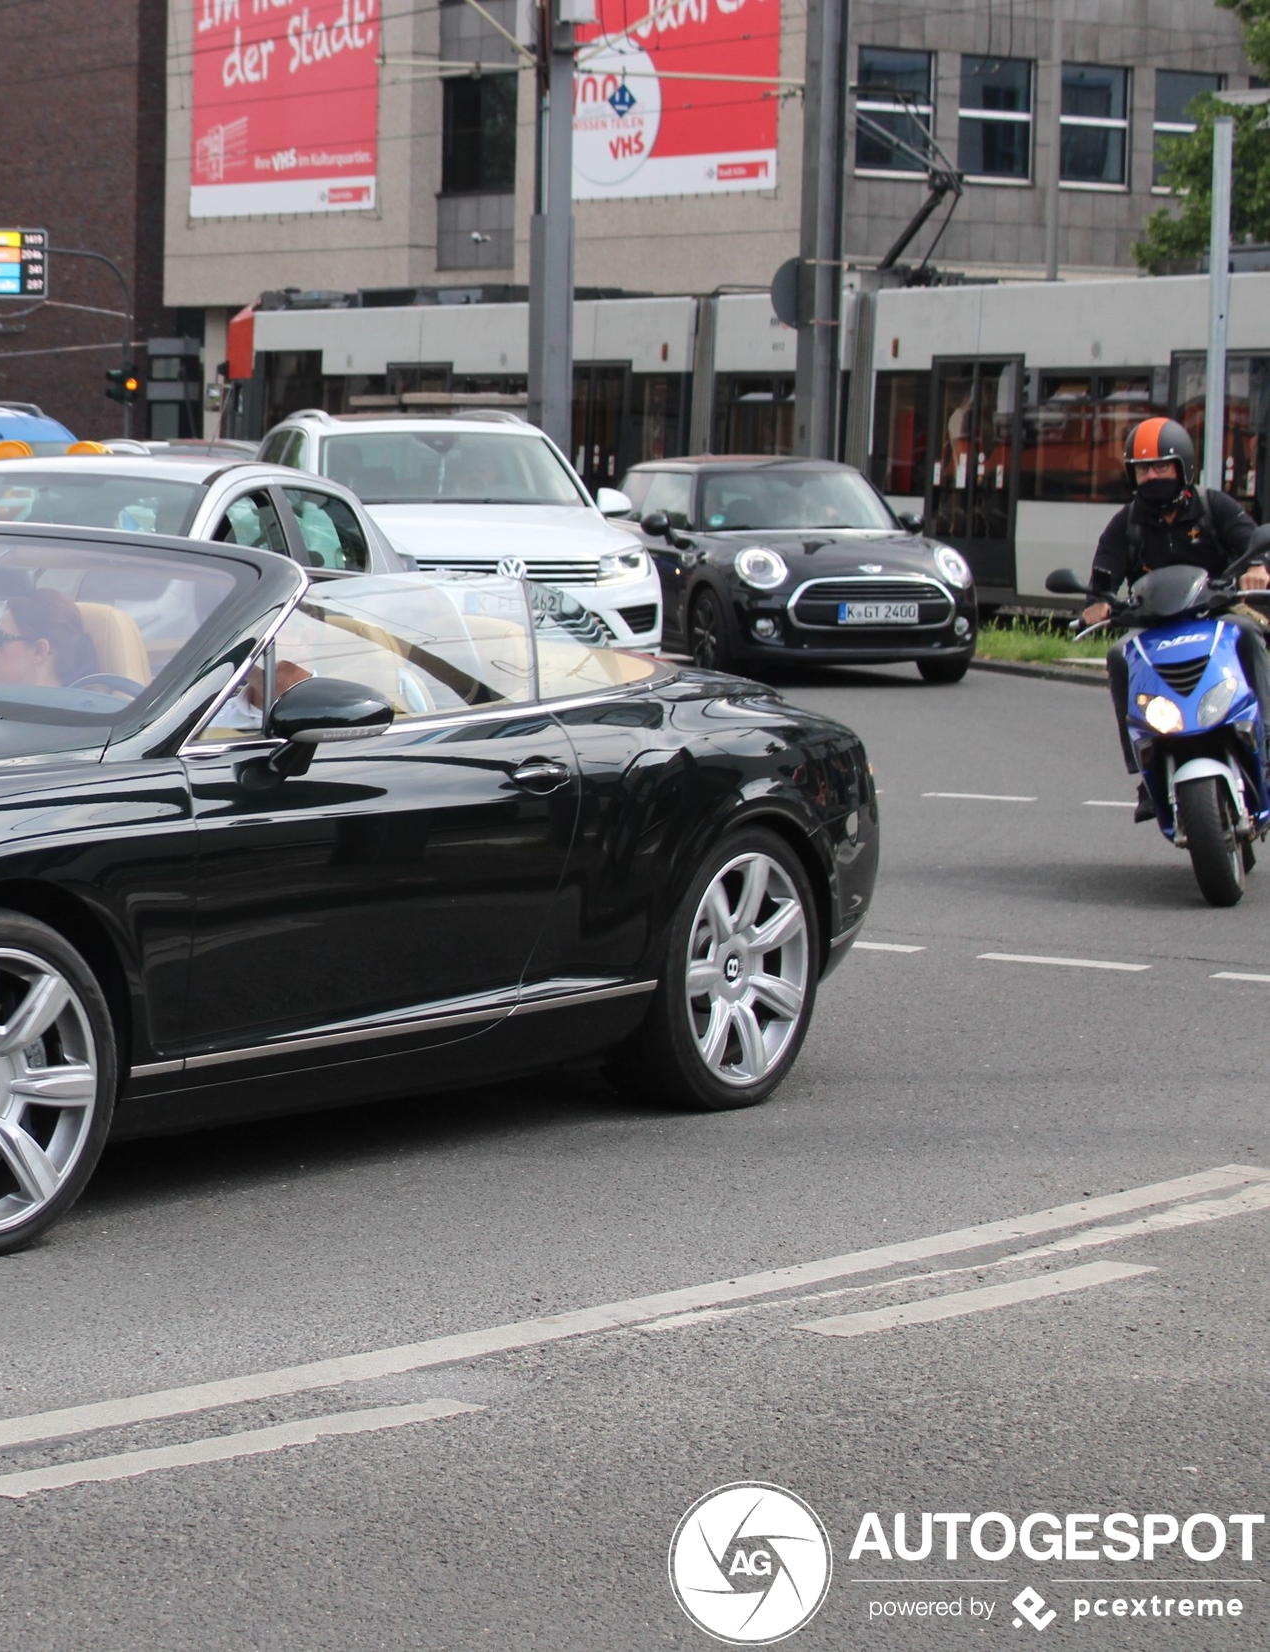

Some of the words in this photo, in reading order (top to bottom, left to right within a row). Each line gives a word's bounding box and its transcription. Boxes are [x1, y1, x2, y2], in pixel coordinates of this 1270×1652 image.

[223, 26, 275, 87] der
[287, 0, 374, 73] Stadt!
[609, 131, 644, 160] VHS
[272, 148, 297, 171] VHS
[847, 605, 855, 618] K
[884, 605, 916, 618] 2400
